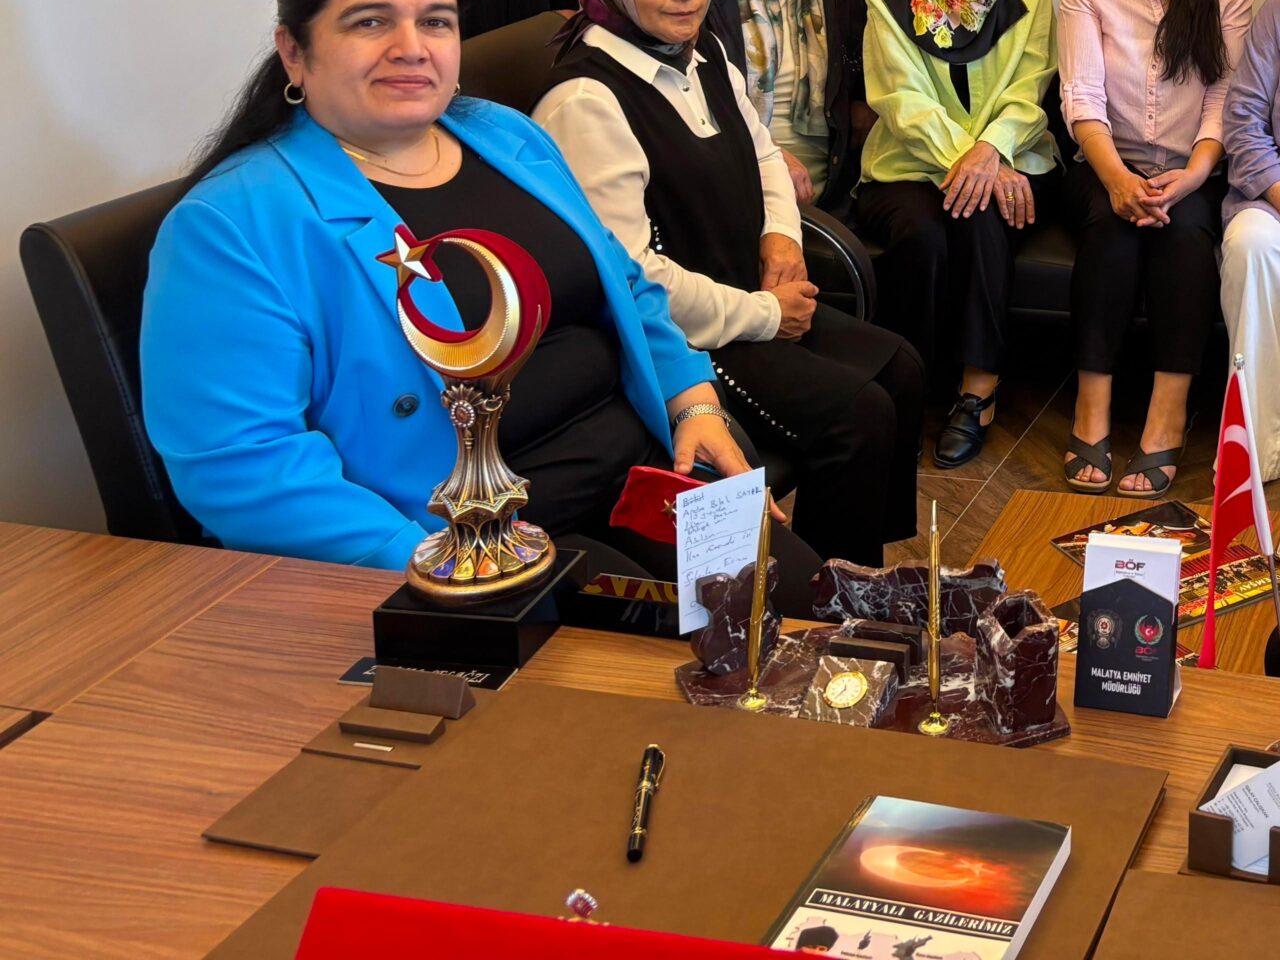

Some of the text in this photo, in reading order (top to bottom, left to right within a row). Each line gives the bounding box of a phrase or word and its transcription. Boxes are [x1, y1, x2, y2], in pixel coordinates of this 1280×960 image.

[1115, 558, 1146, 571] BÖF
[1090, 667, 1152, 684] MALATYA EMNİYET
[1101, 680, 1142, 695] MÜDÜRLÜĞÜ
[819, 892, 1015, 936] MALATYALI GAZİLERİMİZ
